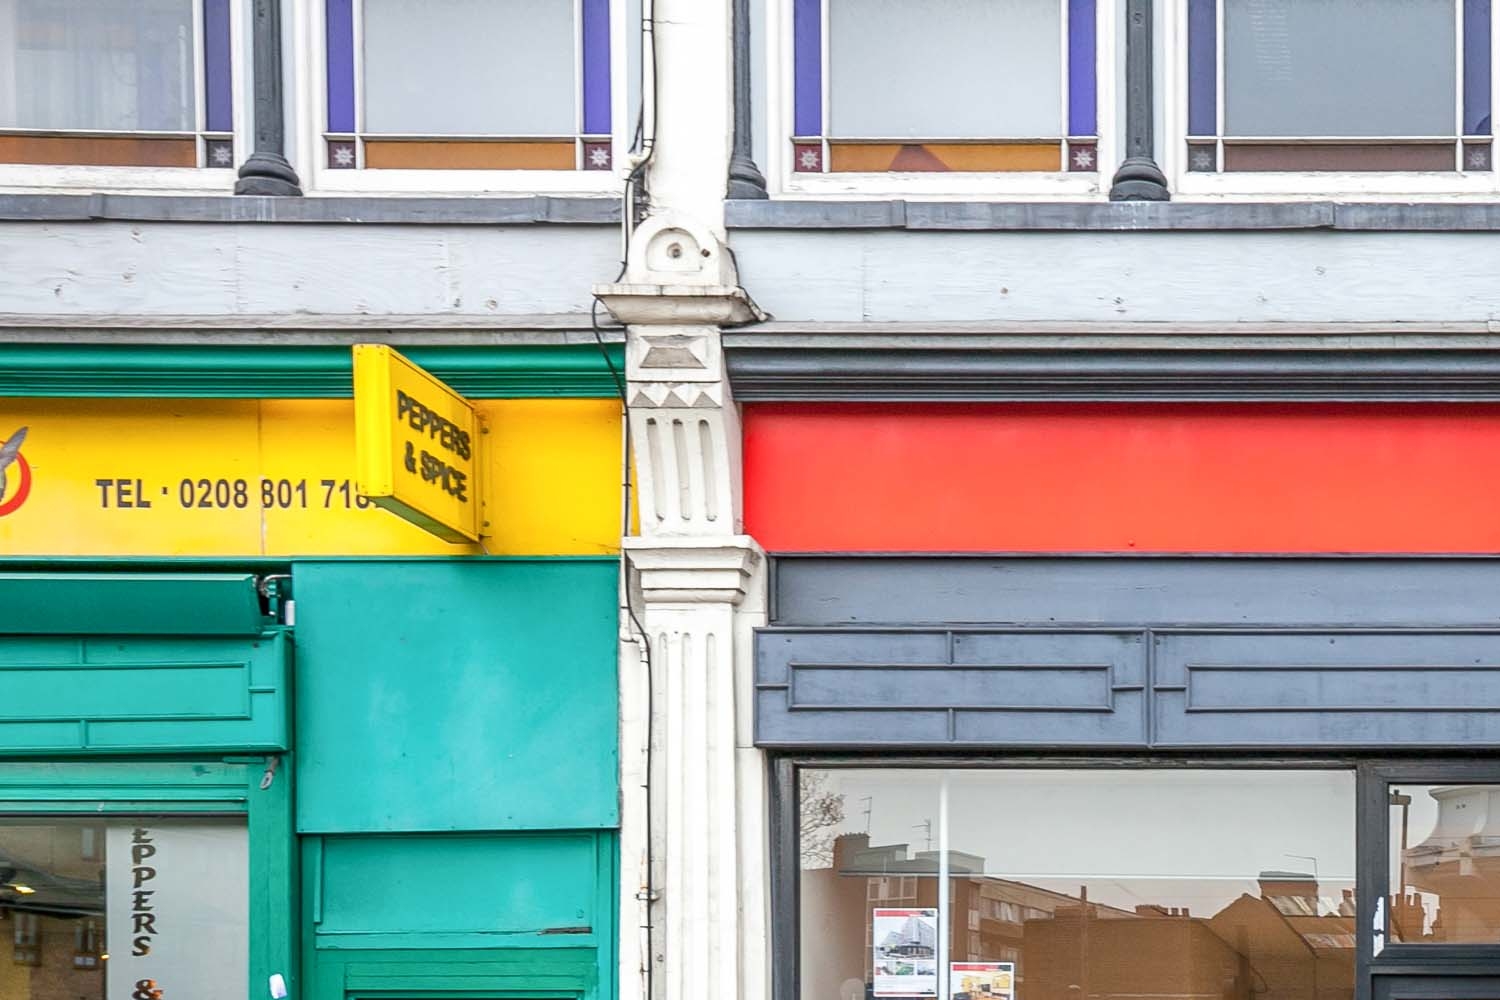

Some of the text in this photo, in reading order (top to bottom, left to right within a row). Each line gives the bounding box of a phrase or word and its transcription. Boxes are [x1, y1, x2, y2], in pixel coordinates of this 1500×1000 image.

[397, 389, 472, 462] PEPPERS
[96, 478, 152, 509] TEL
[179, 478, 249, 510] 0208
[261, 478, 308, 510] 801
[405, 440, 469, 503] & SPICE
